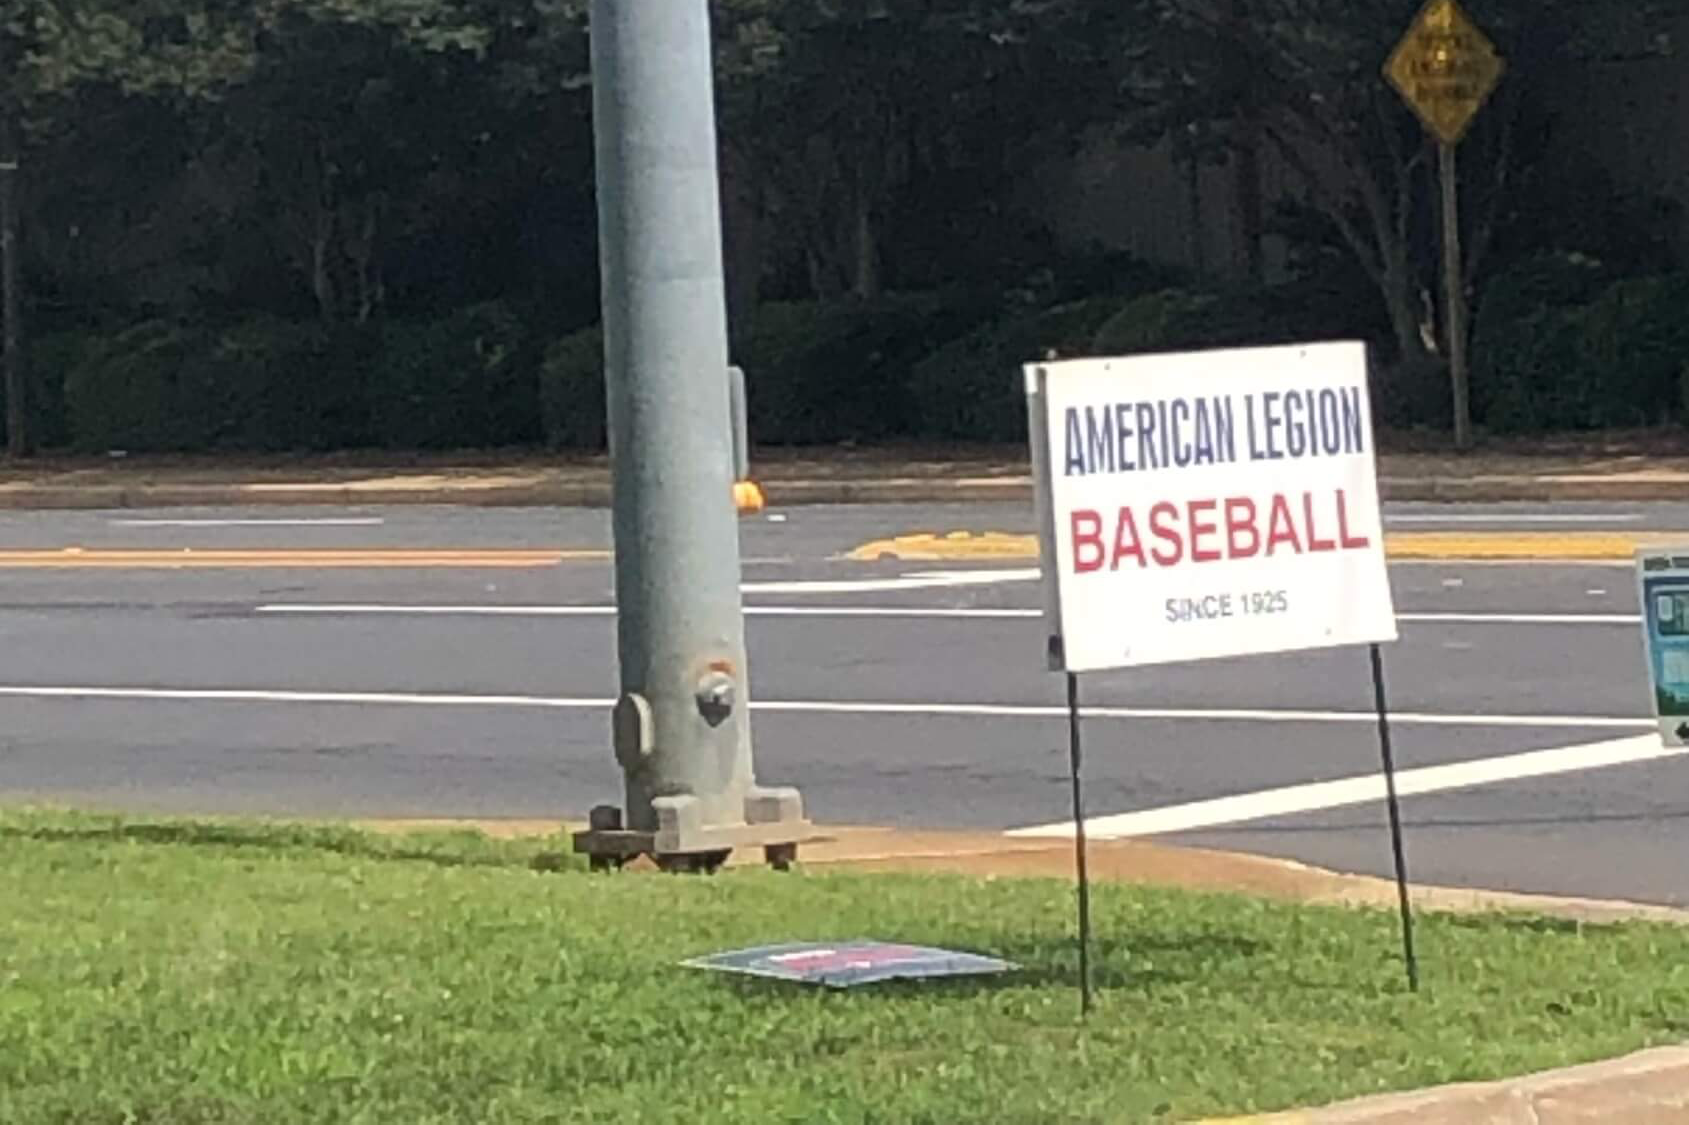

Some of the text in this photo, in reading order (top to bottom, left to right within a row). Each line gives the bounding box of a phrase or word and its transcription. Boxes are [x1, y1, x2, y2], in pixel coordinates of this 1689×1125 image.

[1065, 386, 1363, 476] AMERICAN LEGION
[1070, 489, 1369, 573] BASEBALL
[1165, 590, 1287, 622] SINCE 1925
